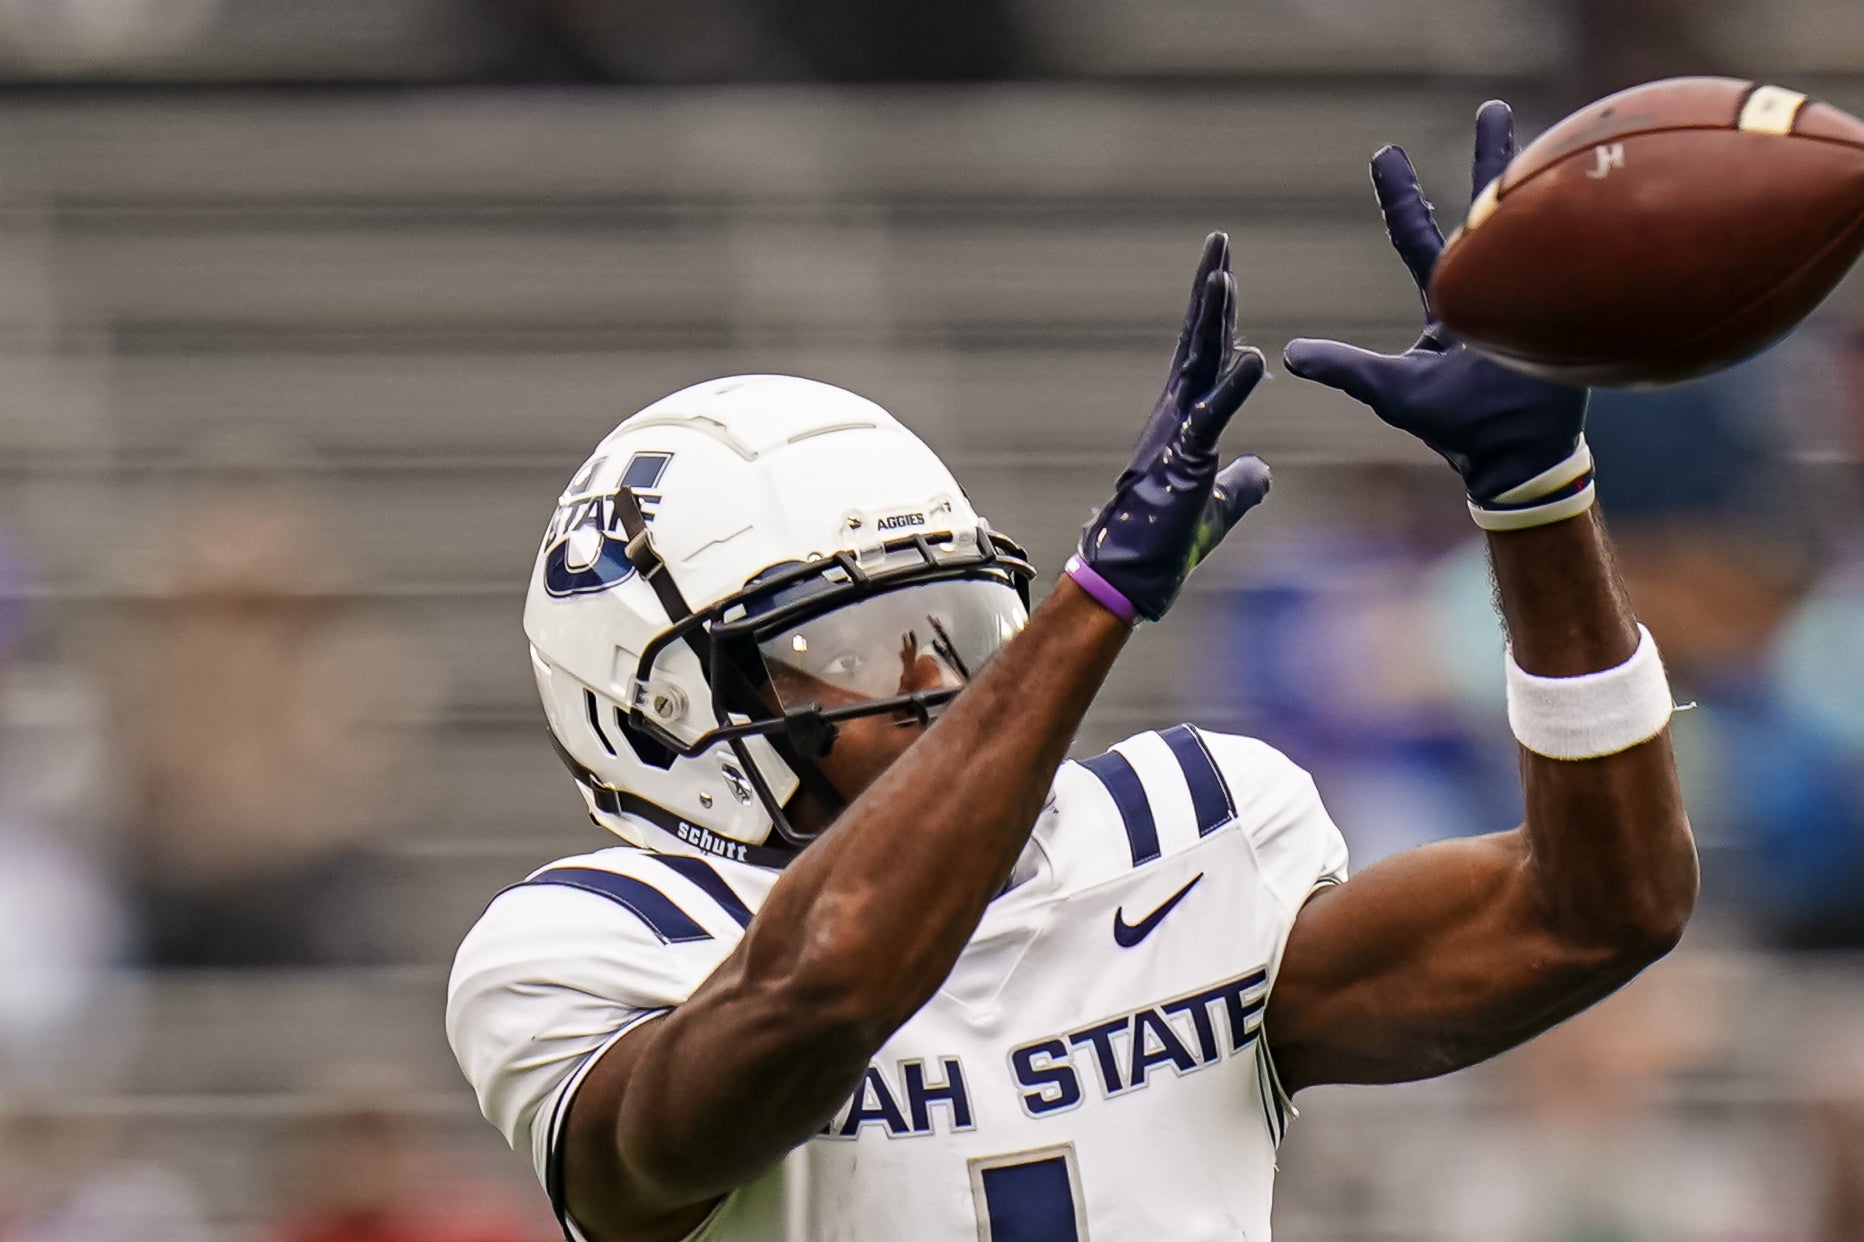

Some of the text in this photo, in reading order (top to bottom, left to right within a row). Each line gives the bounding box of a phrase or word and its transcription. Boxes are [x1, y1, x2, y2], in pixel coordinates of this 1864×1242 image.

[877, 512, 926, 532] AGGIES
[816, 963, 1270, 1141] AH STATE
